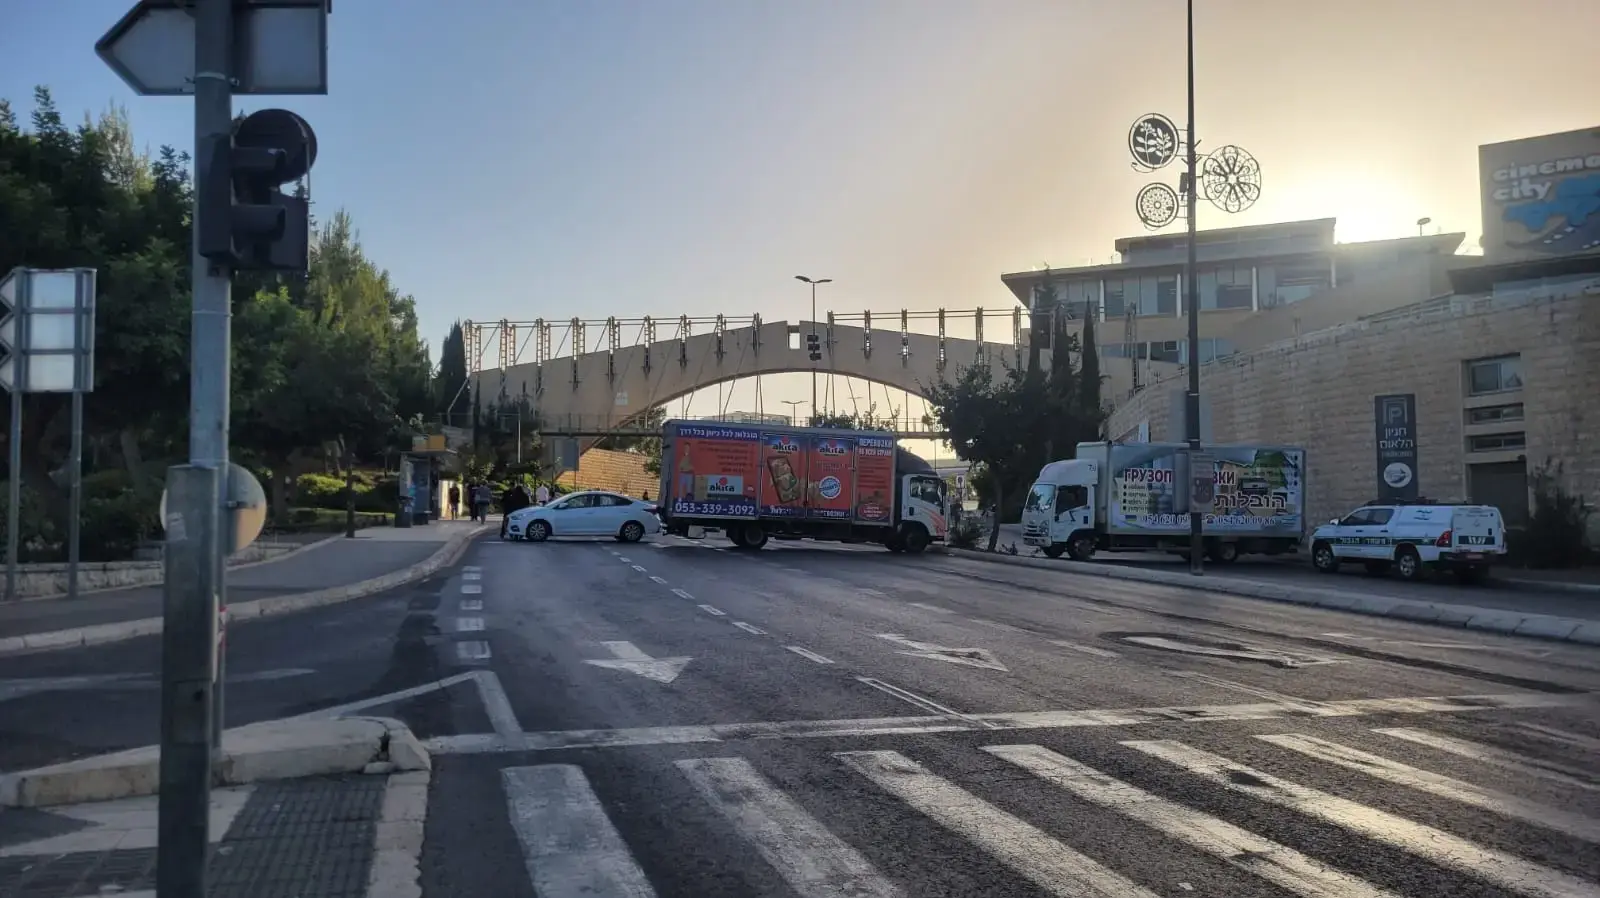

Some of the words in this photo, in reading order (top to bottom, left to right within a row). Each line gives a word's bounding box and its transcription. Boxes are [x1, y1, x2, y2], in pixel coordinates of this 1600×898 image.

[1492, 178, 1552, 200] city
[680, 427, 691, 436] דרך
[692, 428, 705, 436] בכל
[721, 429, 734, 437] לכל
[734, 430, 758, 439] הובלות
[1385, 427, 1407, 439] חניון
[772, 441, 798, 451] akita
[1380, 438, 1413, 448] הלאום
[819, 444, 845, 453] akita
[710, 482, 735, 491] akita
[1214, 491, 1287, 509] הובלות
[675, 502, 754, 515] 053-339-3092
